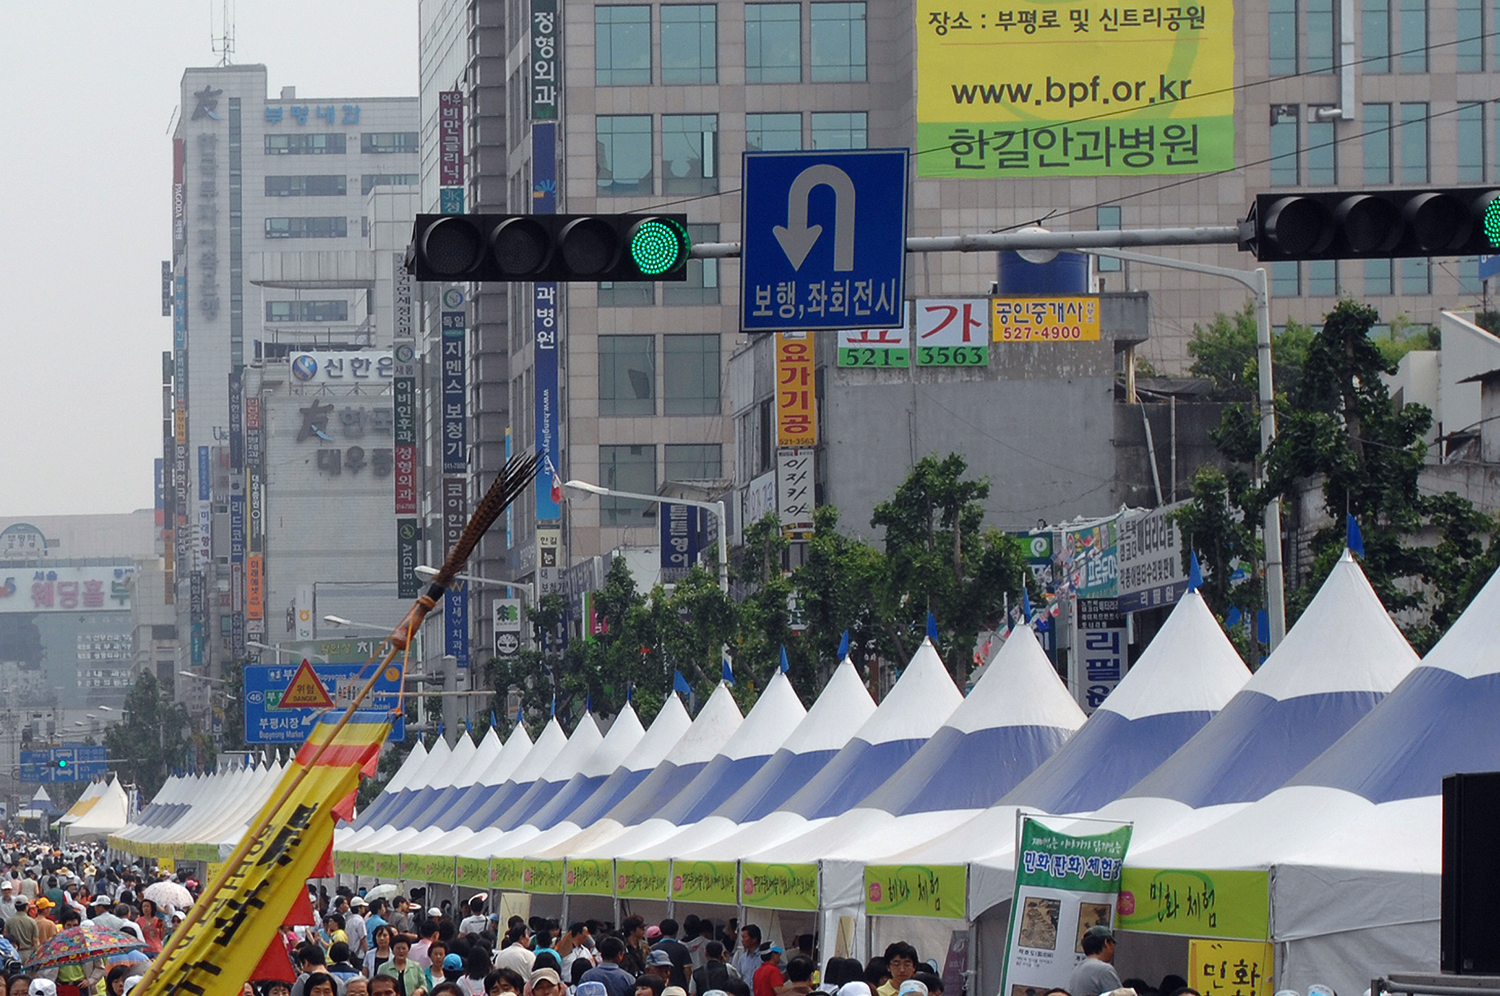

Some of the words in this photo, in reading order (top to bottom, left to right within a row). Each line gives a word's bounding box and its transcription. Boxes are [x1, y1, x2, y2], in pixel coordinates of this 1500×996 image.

[928, 11, 973, 36] 장소
[995, 8, 1061, 35] 부평로
[1069, 8, 1090, 33] 및
[1099, 5, 1206, 32] 신트리공원
[534, 12, 557, 106] 정형외과
[951, 74, 1193, 108] www.bpf.or.kr
[443, 107, 460, 179] 비만클리닉
[948, 124, 1199, 170] 한길안과병원
[537, 284, 556, 350] 과병원
[753, 278, 897, 320] 보행,좌회전시
[996, 301, 1083, 326] 공인중개사
[442, 316, 465, 328] 독일
[1003, 325, 1082, 340] 527-4900
[445, 341, 463, 394] 지멘스
[846, 347, 905, 366] 521-
[921, 347, 984, 365] 3563
[780, 343, 812, 434] 요가기공
[397, 380, 413, 442] 이비인후과
[445, 403, 464, 457] 보청기
[779, 438, 815, 446] 521-3563
[397, 447, 413, 501] 성형외과
[784, 458, 809, 517] 이자카야
[231, 500, 243, 557] 리드코프
[402, 543, 413, 580] AIGLE
[31, 579, 105, 609] 웨딩홀
[250, 693, 262, 701] 46
[297, 684, 315, 694] 위험
[259, 717, 299, 729] 부평시장
[1150, 881, 1180, 923] 민화
[1186, 882, 1217, 929] 체험
[1203, 958, 1261, 990] 민화
